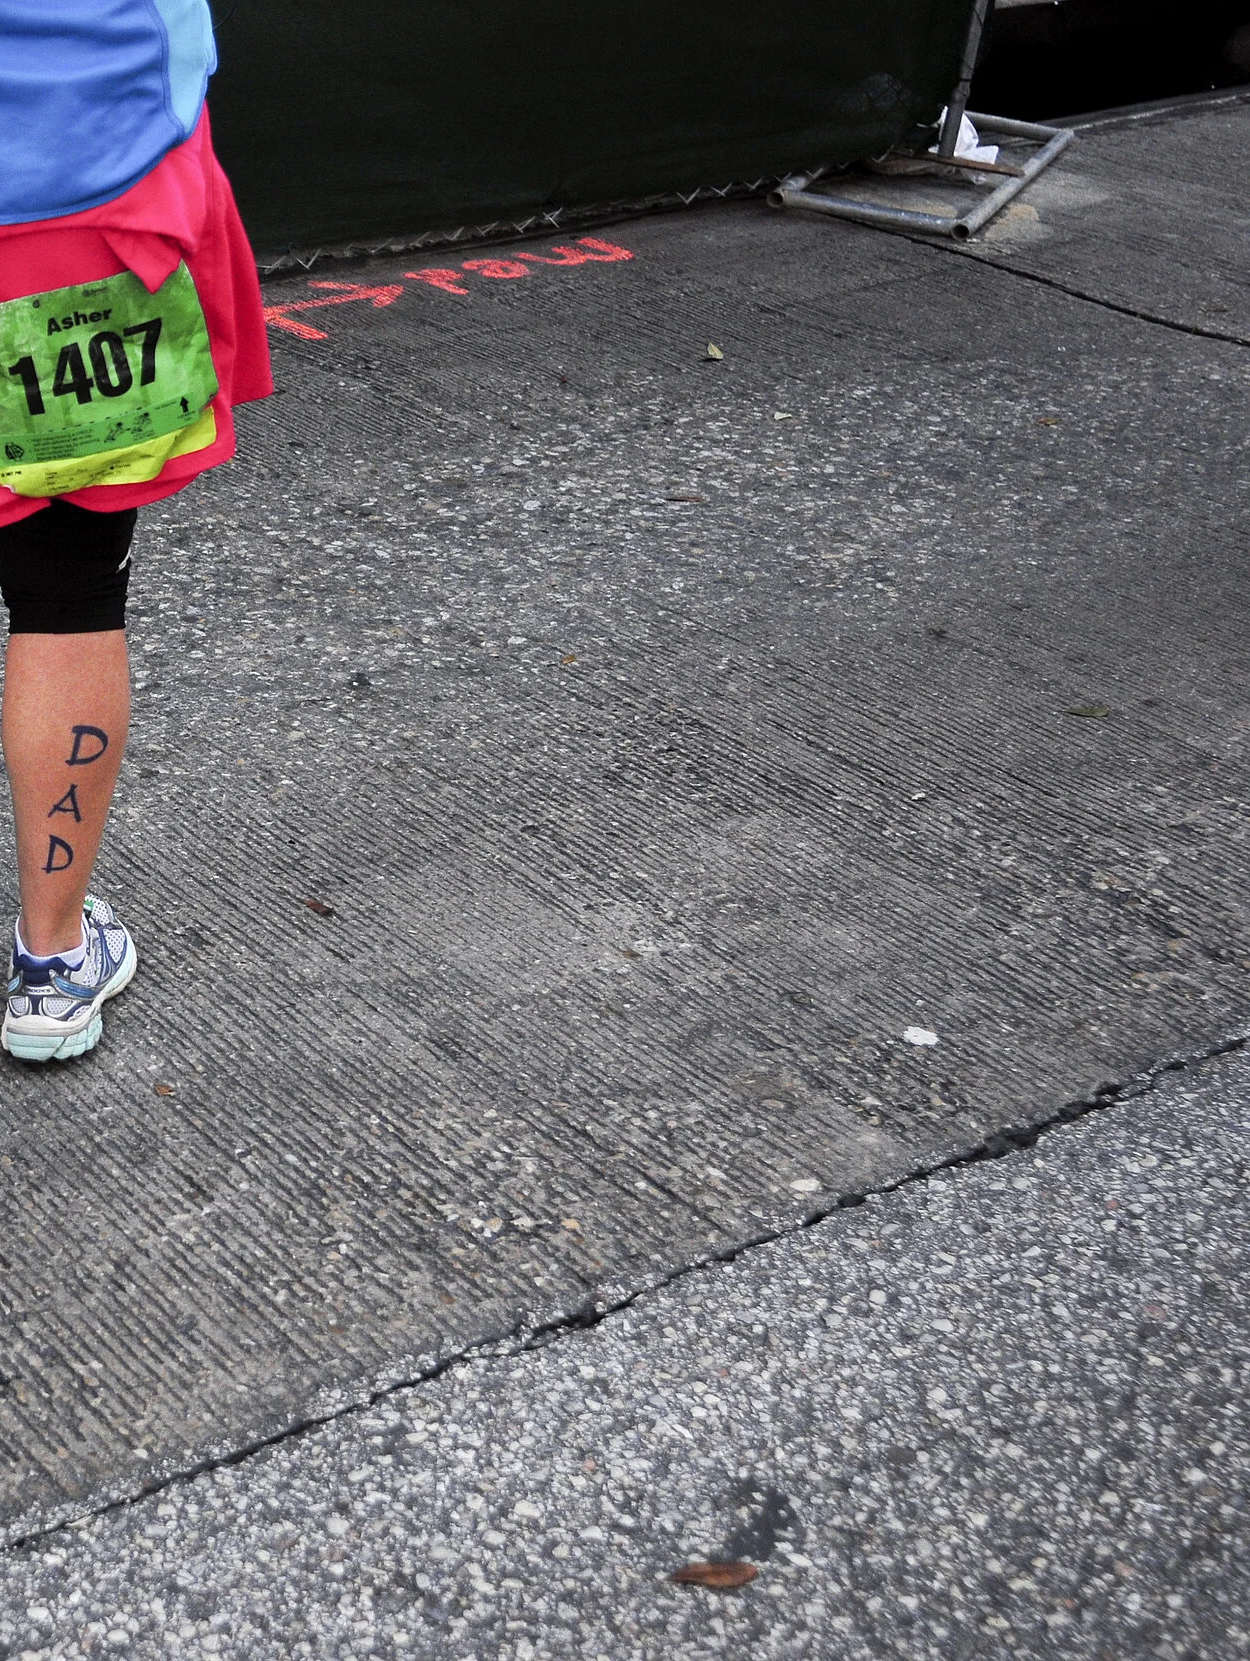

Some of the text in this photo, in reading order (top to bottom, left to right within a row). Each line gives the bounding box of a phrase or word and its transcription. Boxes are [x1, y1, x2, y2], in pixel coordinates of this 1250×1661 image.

[8, 317, 162, 417] 1407
[47, 308, 112, 336] Asher
[41, 725, 109, 874] DAD
